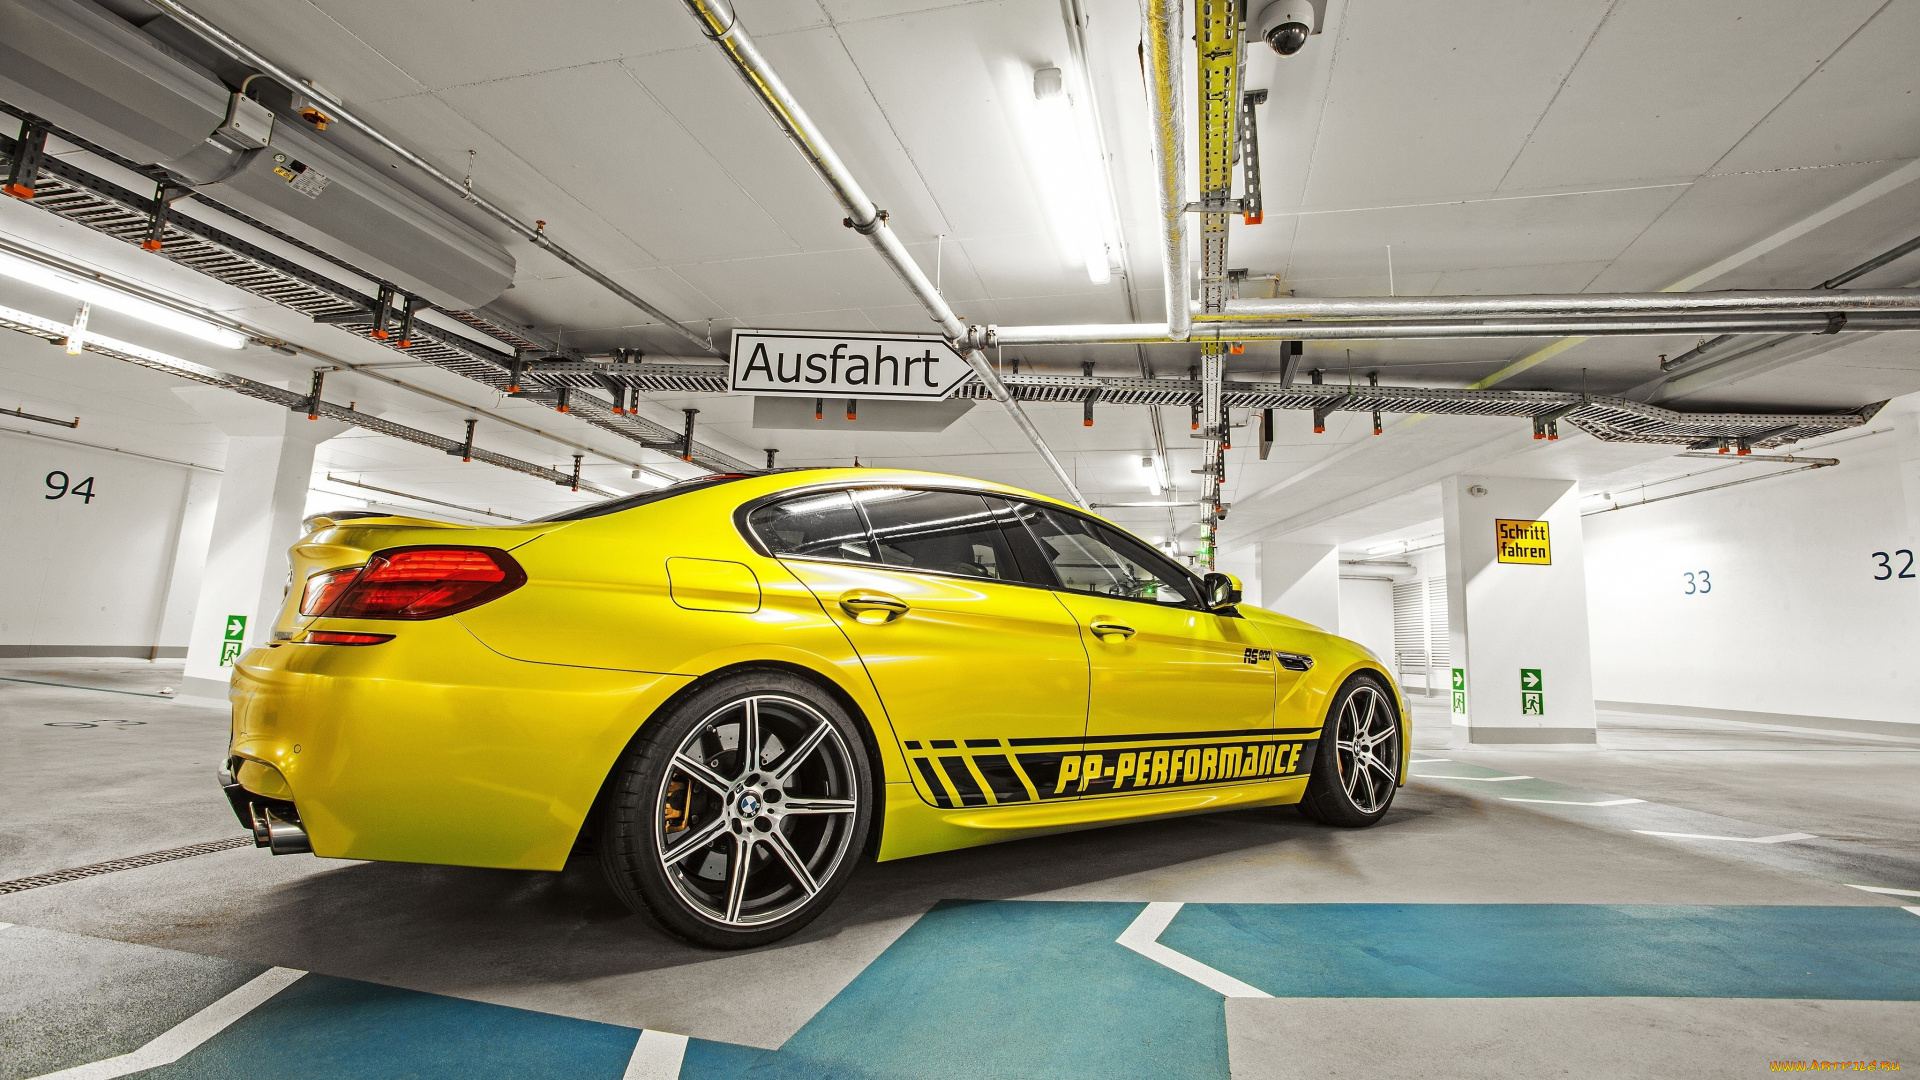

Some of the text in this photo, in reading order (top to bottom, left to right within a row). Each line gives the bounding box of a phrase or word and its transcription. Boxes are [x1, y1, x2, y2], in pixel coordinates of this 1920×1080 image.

[742, 342, 940, 388] Ausfahrt
[45, 470, 96, 504] 94
[1500, 523, 1546, 540] Schritt
[1501, 541, 1546, 558] fahren
[1871, 549, 1916, 580] 32
[1683, 570, 1712, 595] 33
[1053, 744, 1303, 794] PP-PERFORMANCE
